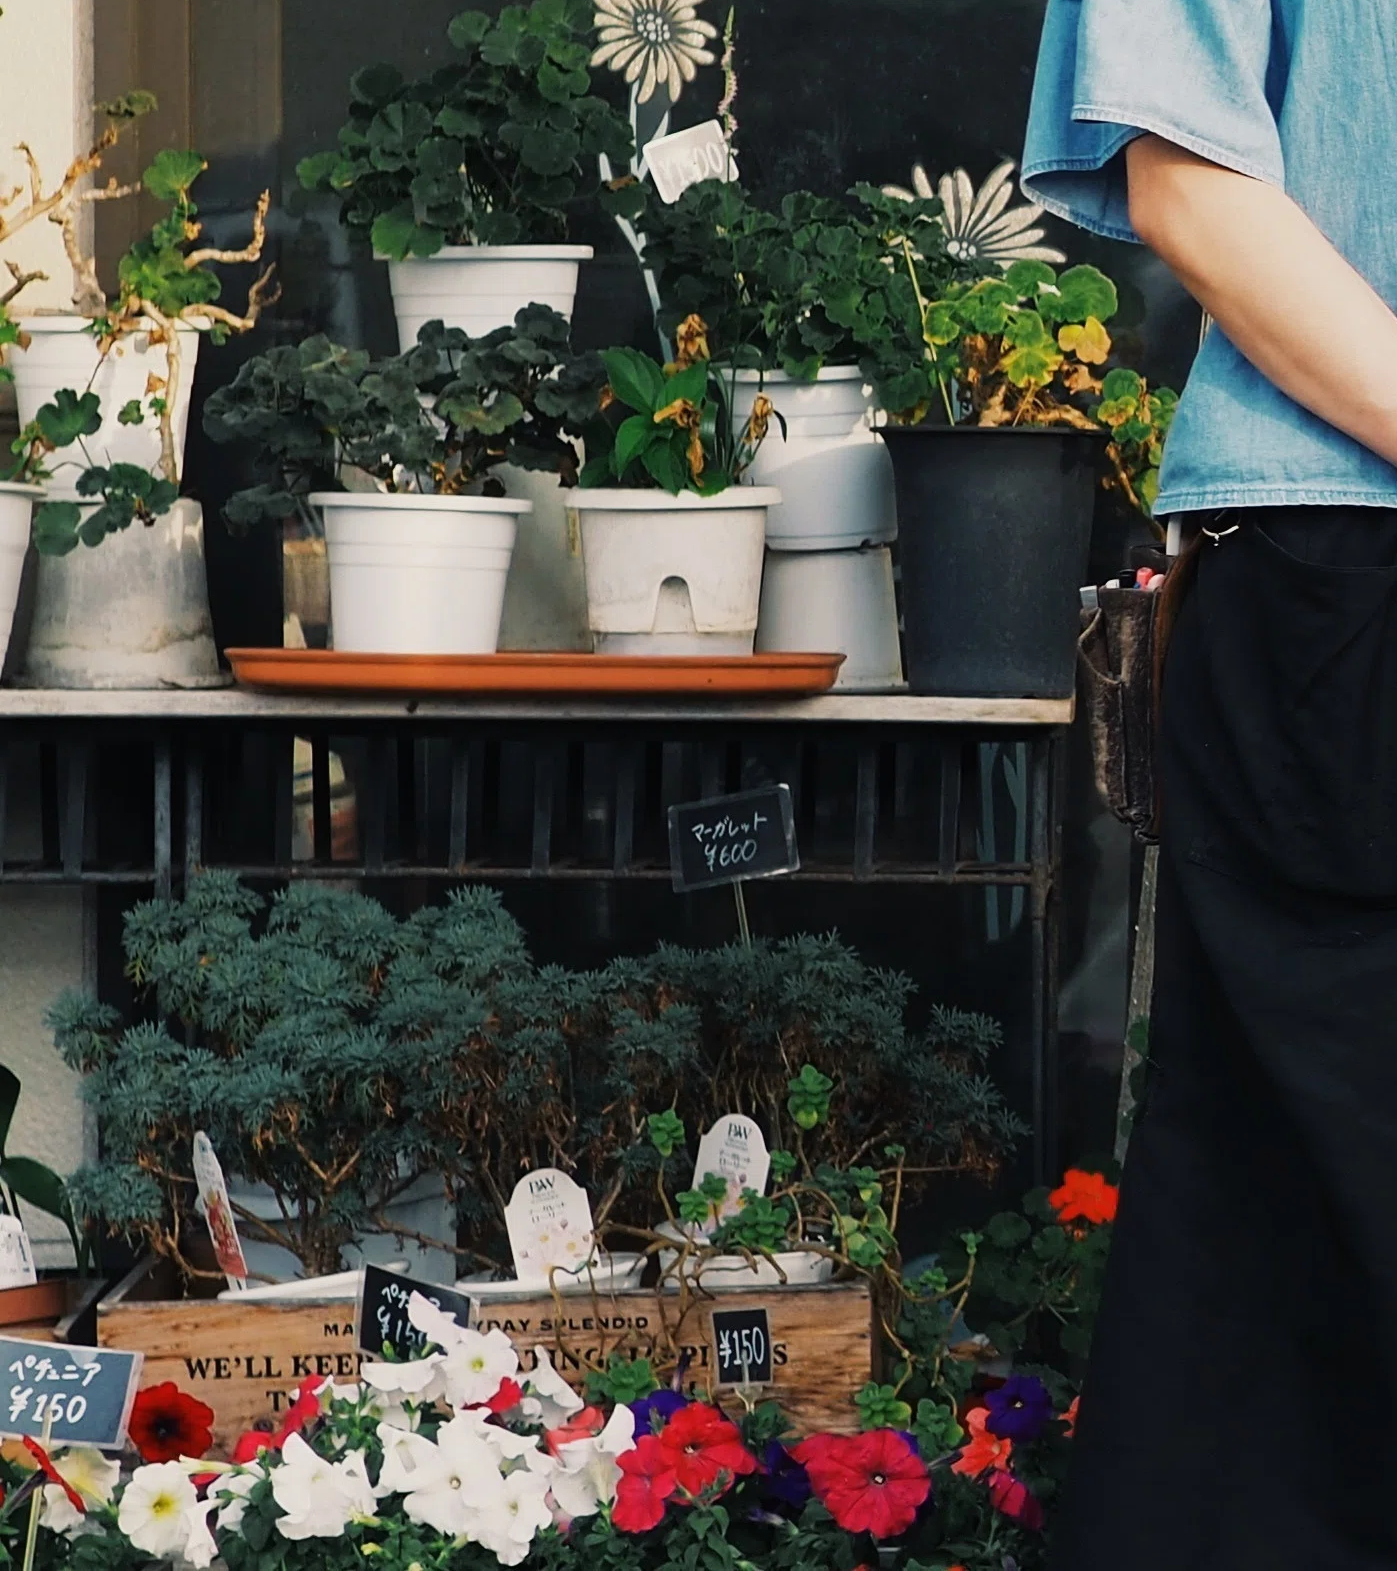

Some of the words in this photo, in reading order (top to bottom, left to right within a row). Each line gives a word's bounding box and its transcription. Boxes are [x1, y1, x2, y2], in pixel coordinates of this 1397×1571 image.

[691, 811, 768, 843] マーガレット
[704, 839, 757, 872] ¥600
[719, 1326, 766, 1369] ¥150
[9, 1355, 101, 1387] ペチュニア
[184, 1355, 282, 1380] WE'LL
[8, 1385, 87, 1424] ¥150
